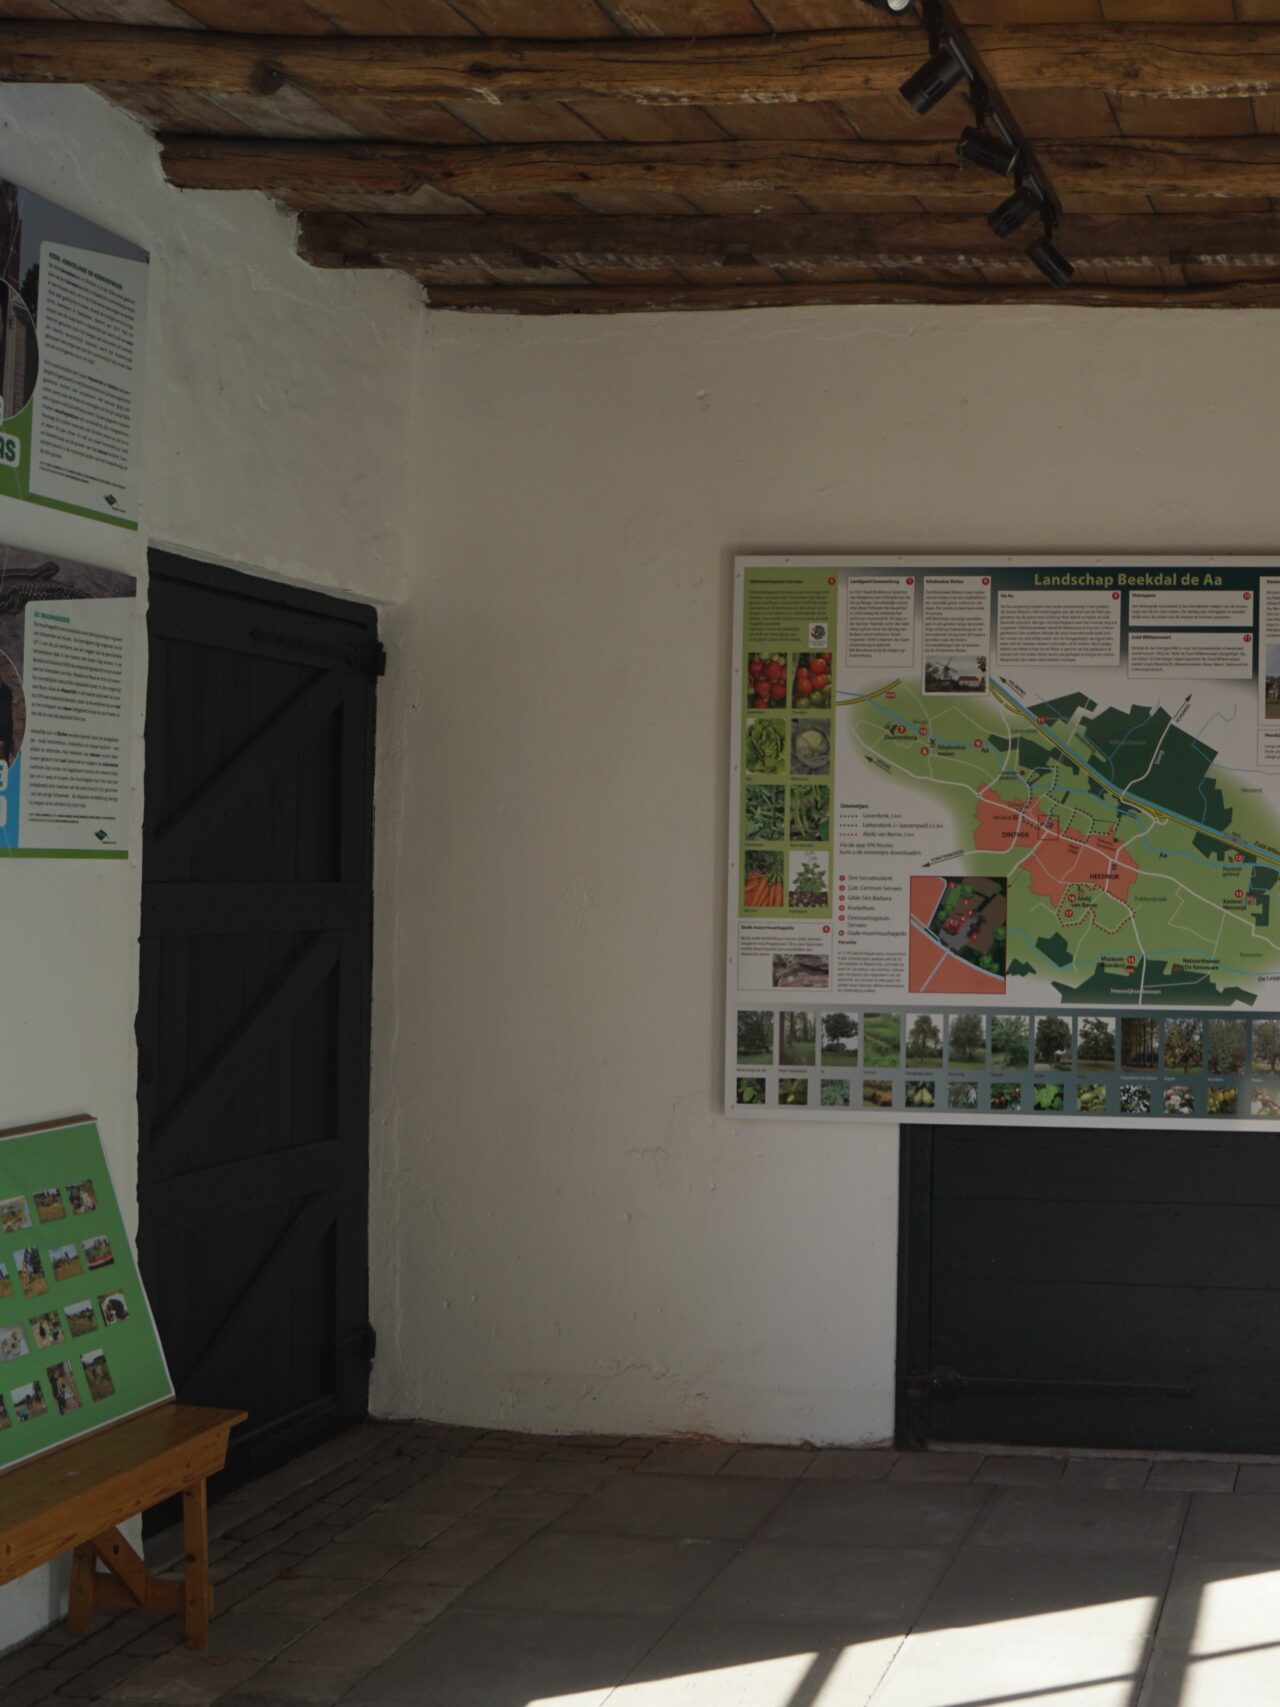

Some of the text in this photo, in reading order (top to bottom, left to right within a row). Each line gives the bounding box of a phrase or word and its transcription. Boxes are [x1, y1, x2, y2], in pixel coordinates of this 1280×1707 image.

[1034, 572, 1222, 588] Landschap Beekdal de Aa
